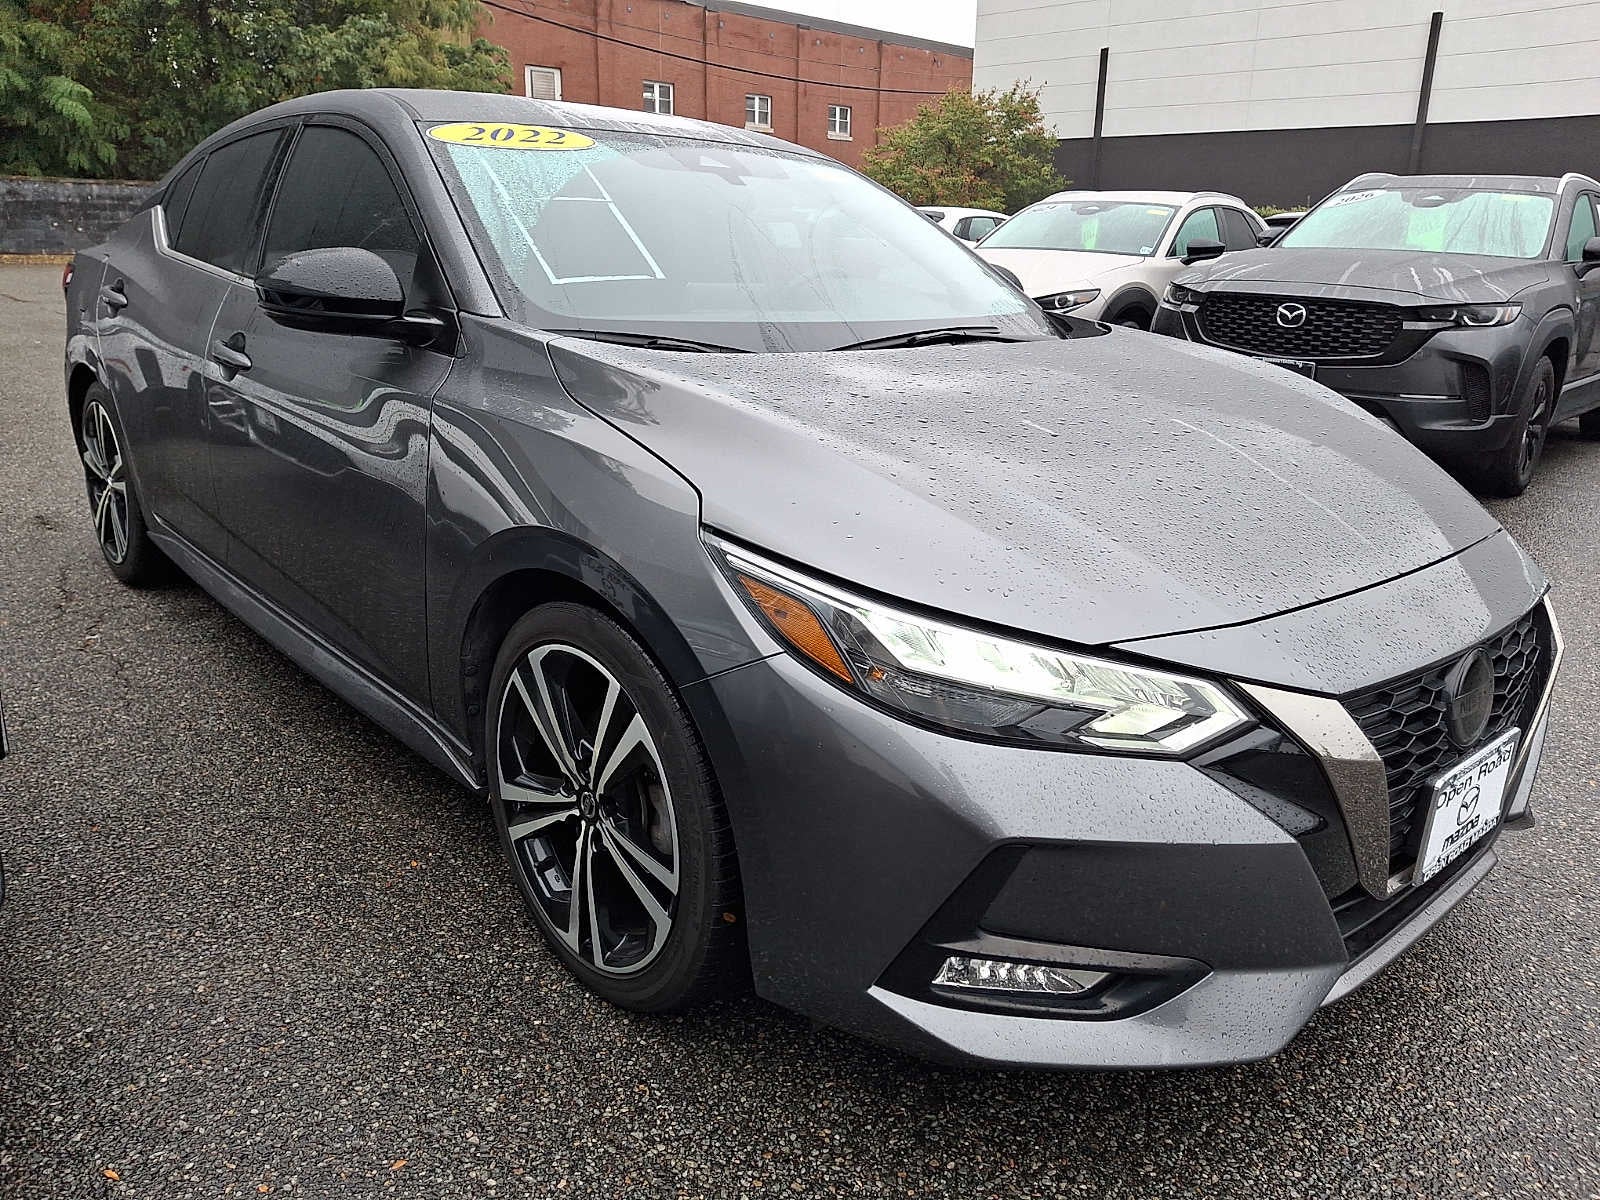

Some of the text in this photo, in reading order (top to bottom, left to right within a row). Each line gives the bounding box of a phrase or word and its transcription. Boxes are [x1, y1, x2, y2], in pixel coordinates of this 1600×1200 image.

[462, 126, 566, 145] 2022
[1436, 775, 1473, 809] Open
[1477, 744, 1513, 780] Road
